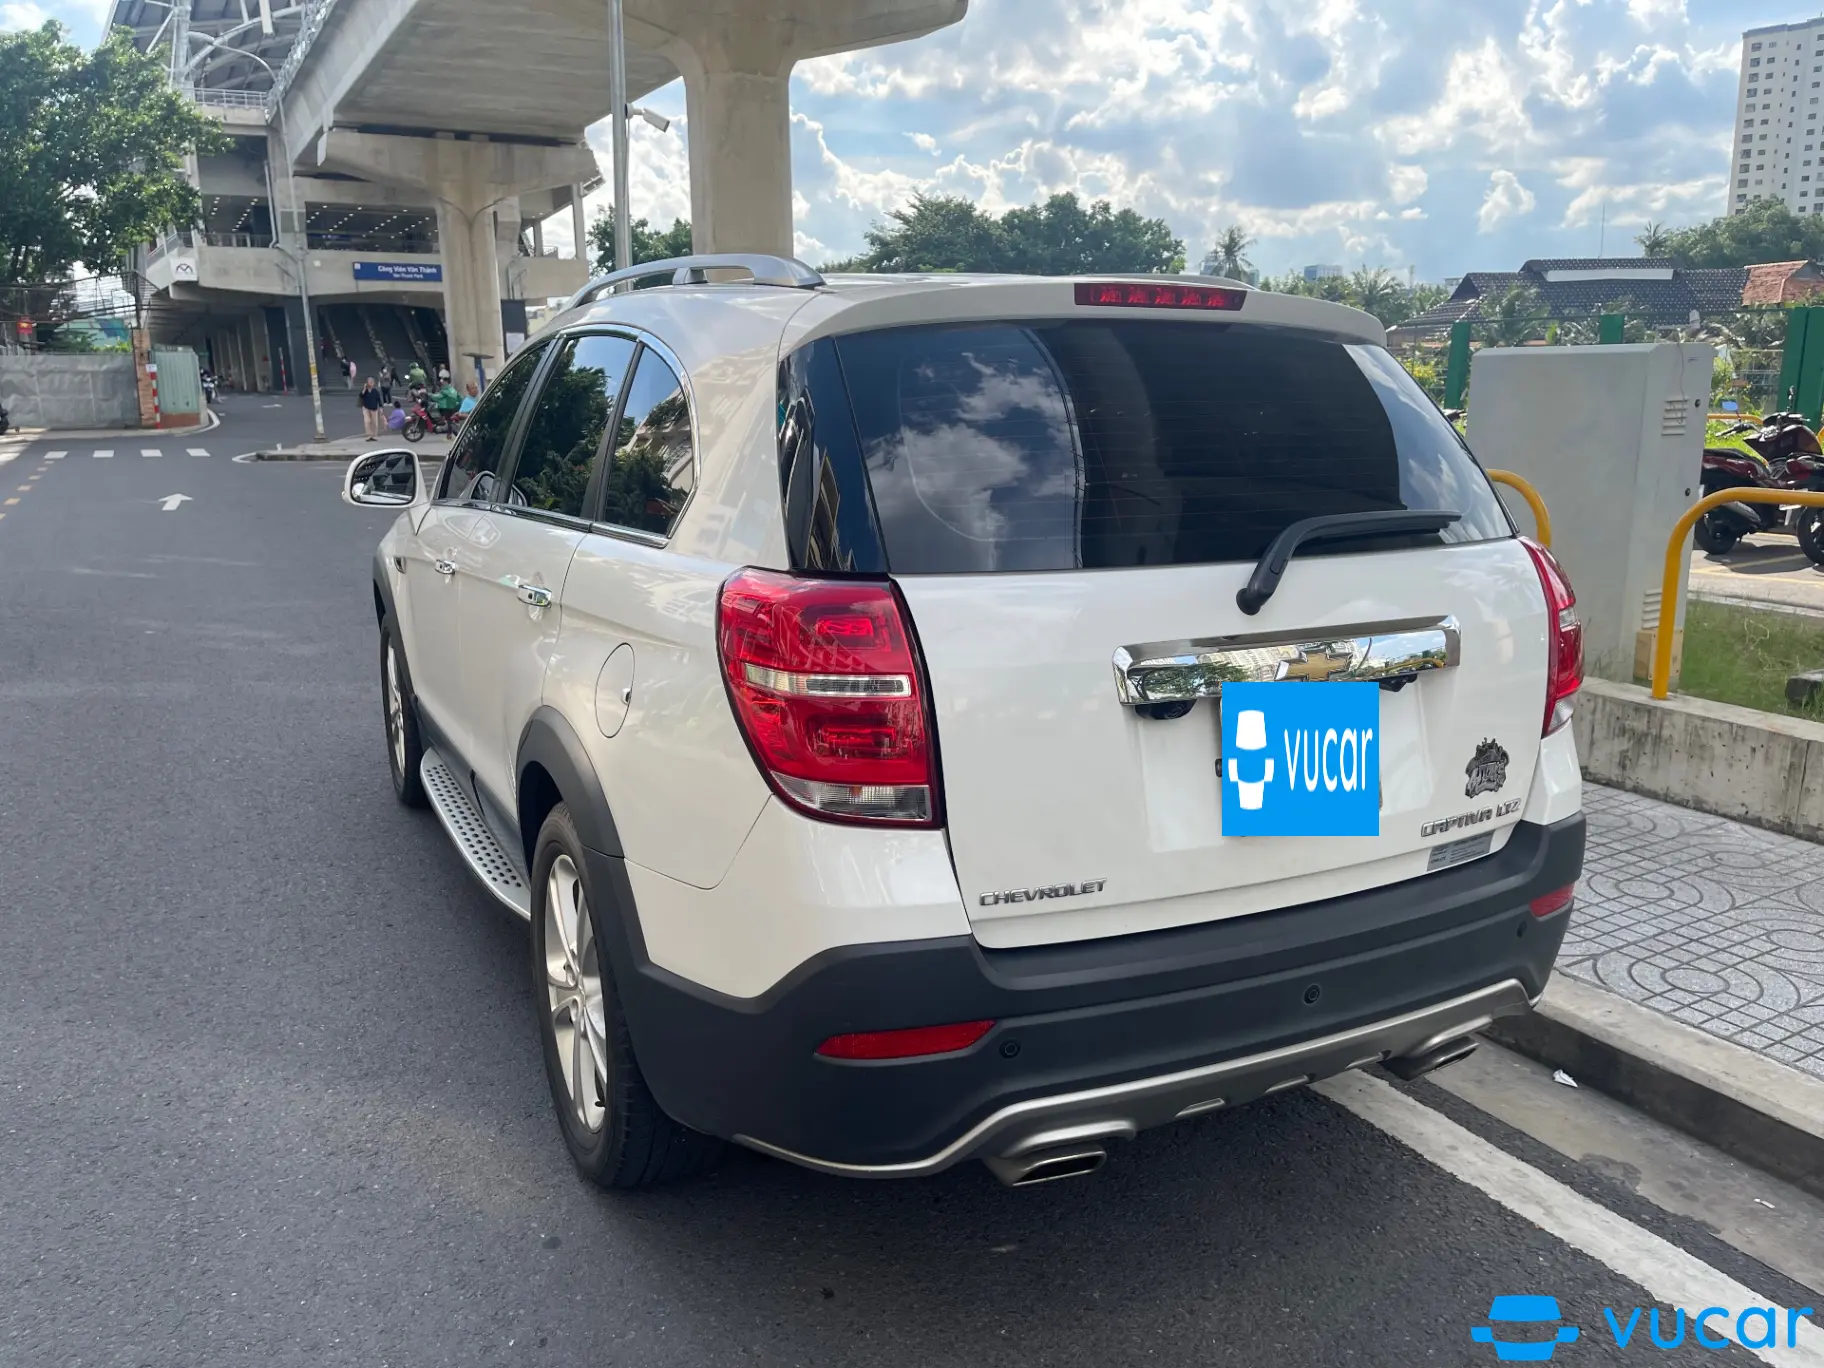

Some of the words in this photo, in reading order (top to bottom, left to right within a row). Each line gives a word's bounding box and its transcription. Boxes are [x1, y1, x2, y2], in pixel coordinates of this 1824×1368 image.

[1421, 807, 1493, 838] CAPTIVA
[1496, 798, 1522, 818] LTZ
[979, 877, 1107, 906] CHEVROLET
